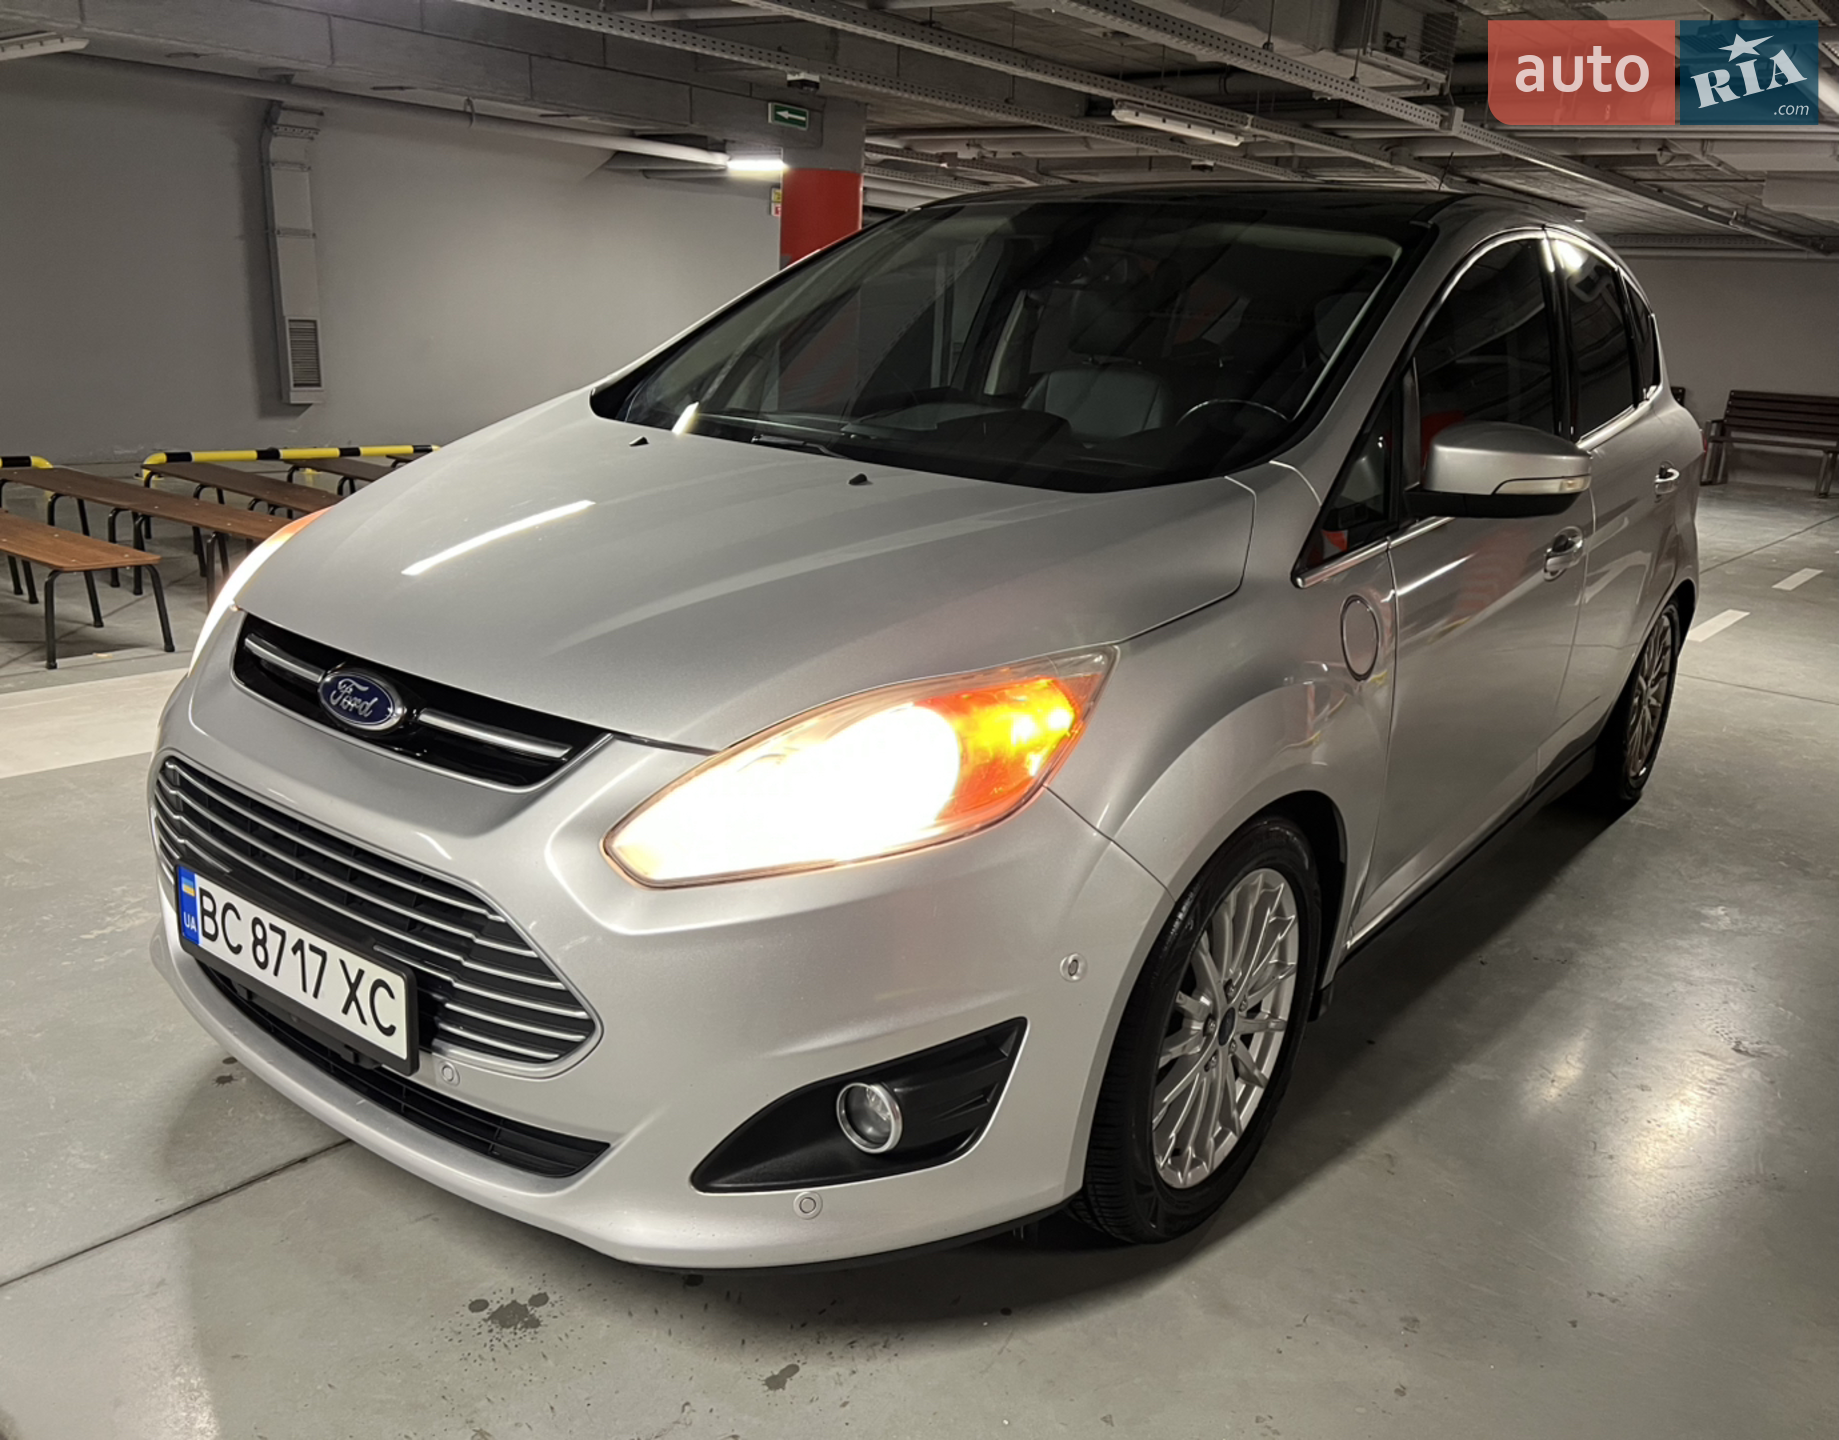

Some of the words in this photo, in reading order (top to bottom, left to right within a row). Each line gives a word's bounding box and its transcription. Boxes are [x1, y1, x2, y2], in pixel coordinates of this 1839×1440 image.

[330, 678, 379, 718] Ford
[183, 911, 198, 932] UA
[198, 886, 243, 955] BC
[251, 916, 328, 999] 8717
[339, 958, 397, 1037] XC
